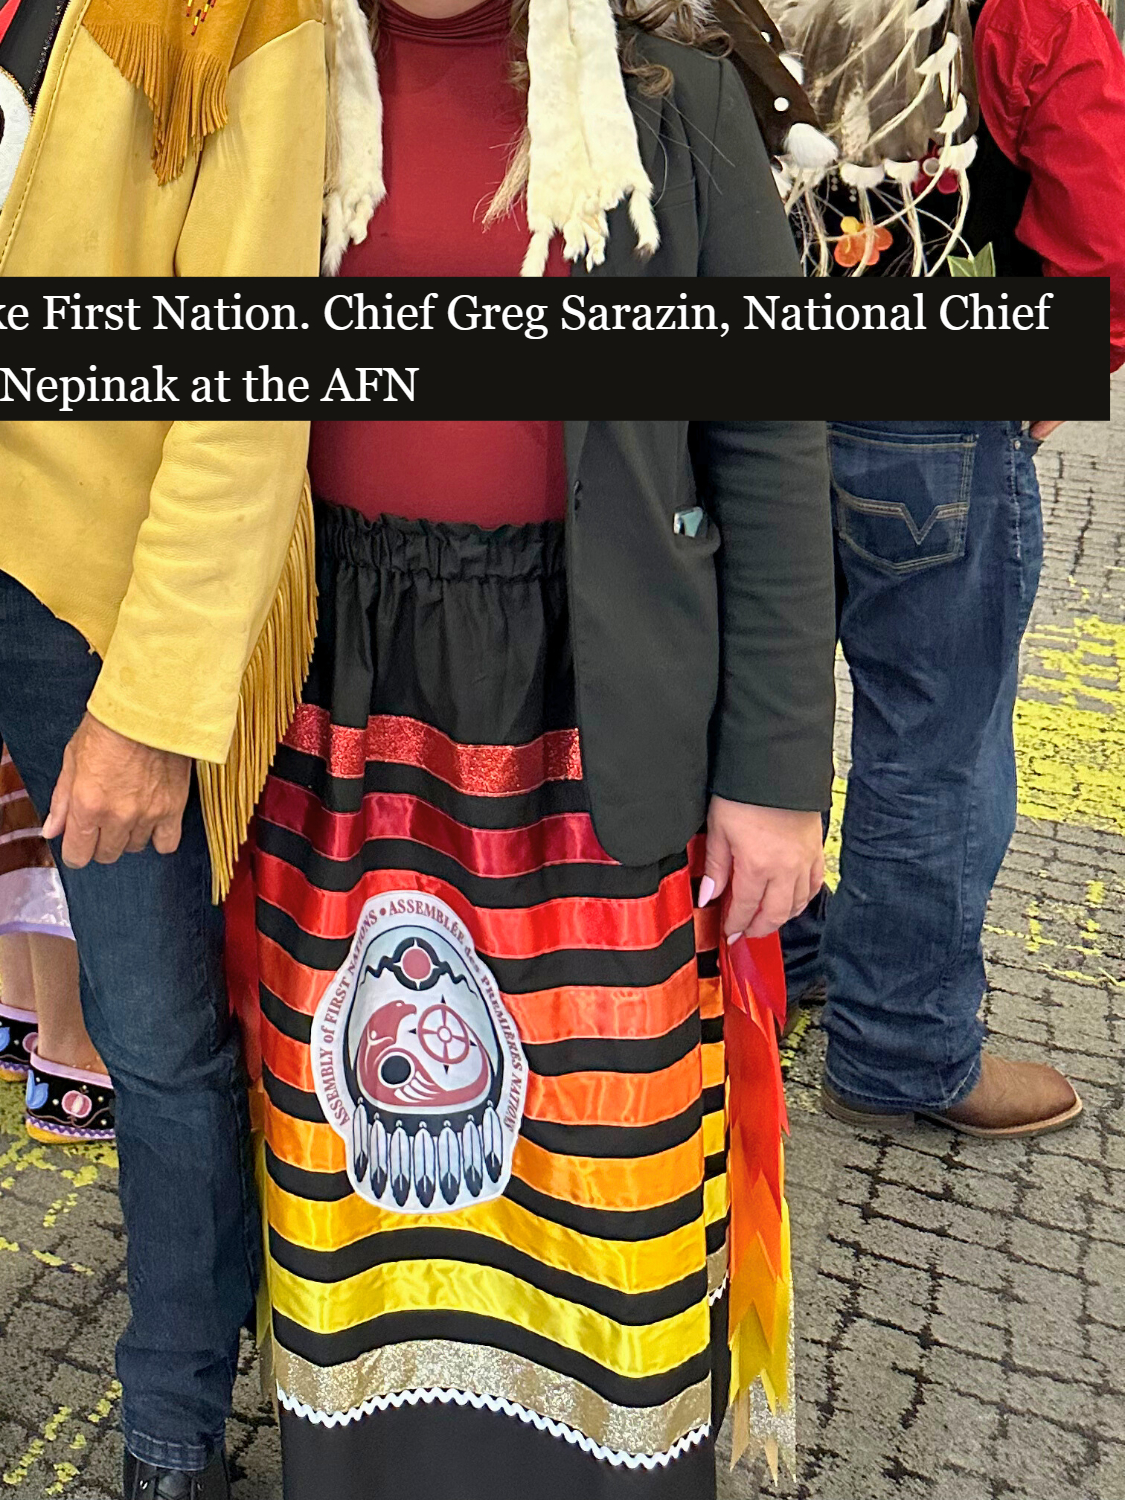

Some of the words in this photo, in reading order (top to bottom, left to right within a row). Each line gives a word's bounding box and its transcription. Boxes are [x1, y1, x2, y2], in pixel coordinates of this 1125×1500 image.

[348, 909, 379, 978] NATIONS
[321, 1022, 336, 1044] of
[325, 975, 351, 1025] FIRST
[388, 899, 466, 945] ASSEMBLÉE
[463, 946, 481, 974] des
[481, 975, 524, 1071] PREMIÈRES
[505, 1072, 524, 1133] NATIONS
[321, 1047, 351, 1127] ASSEMBLY
